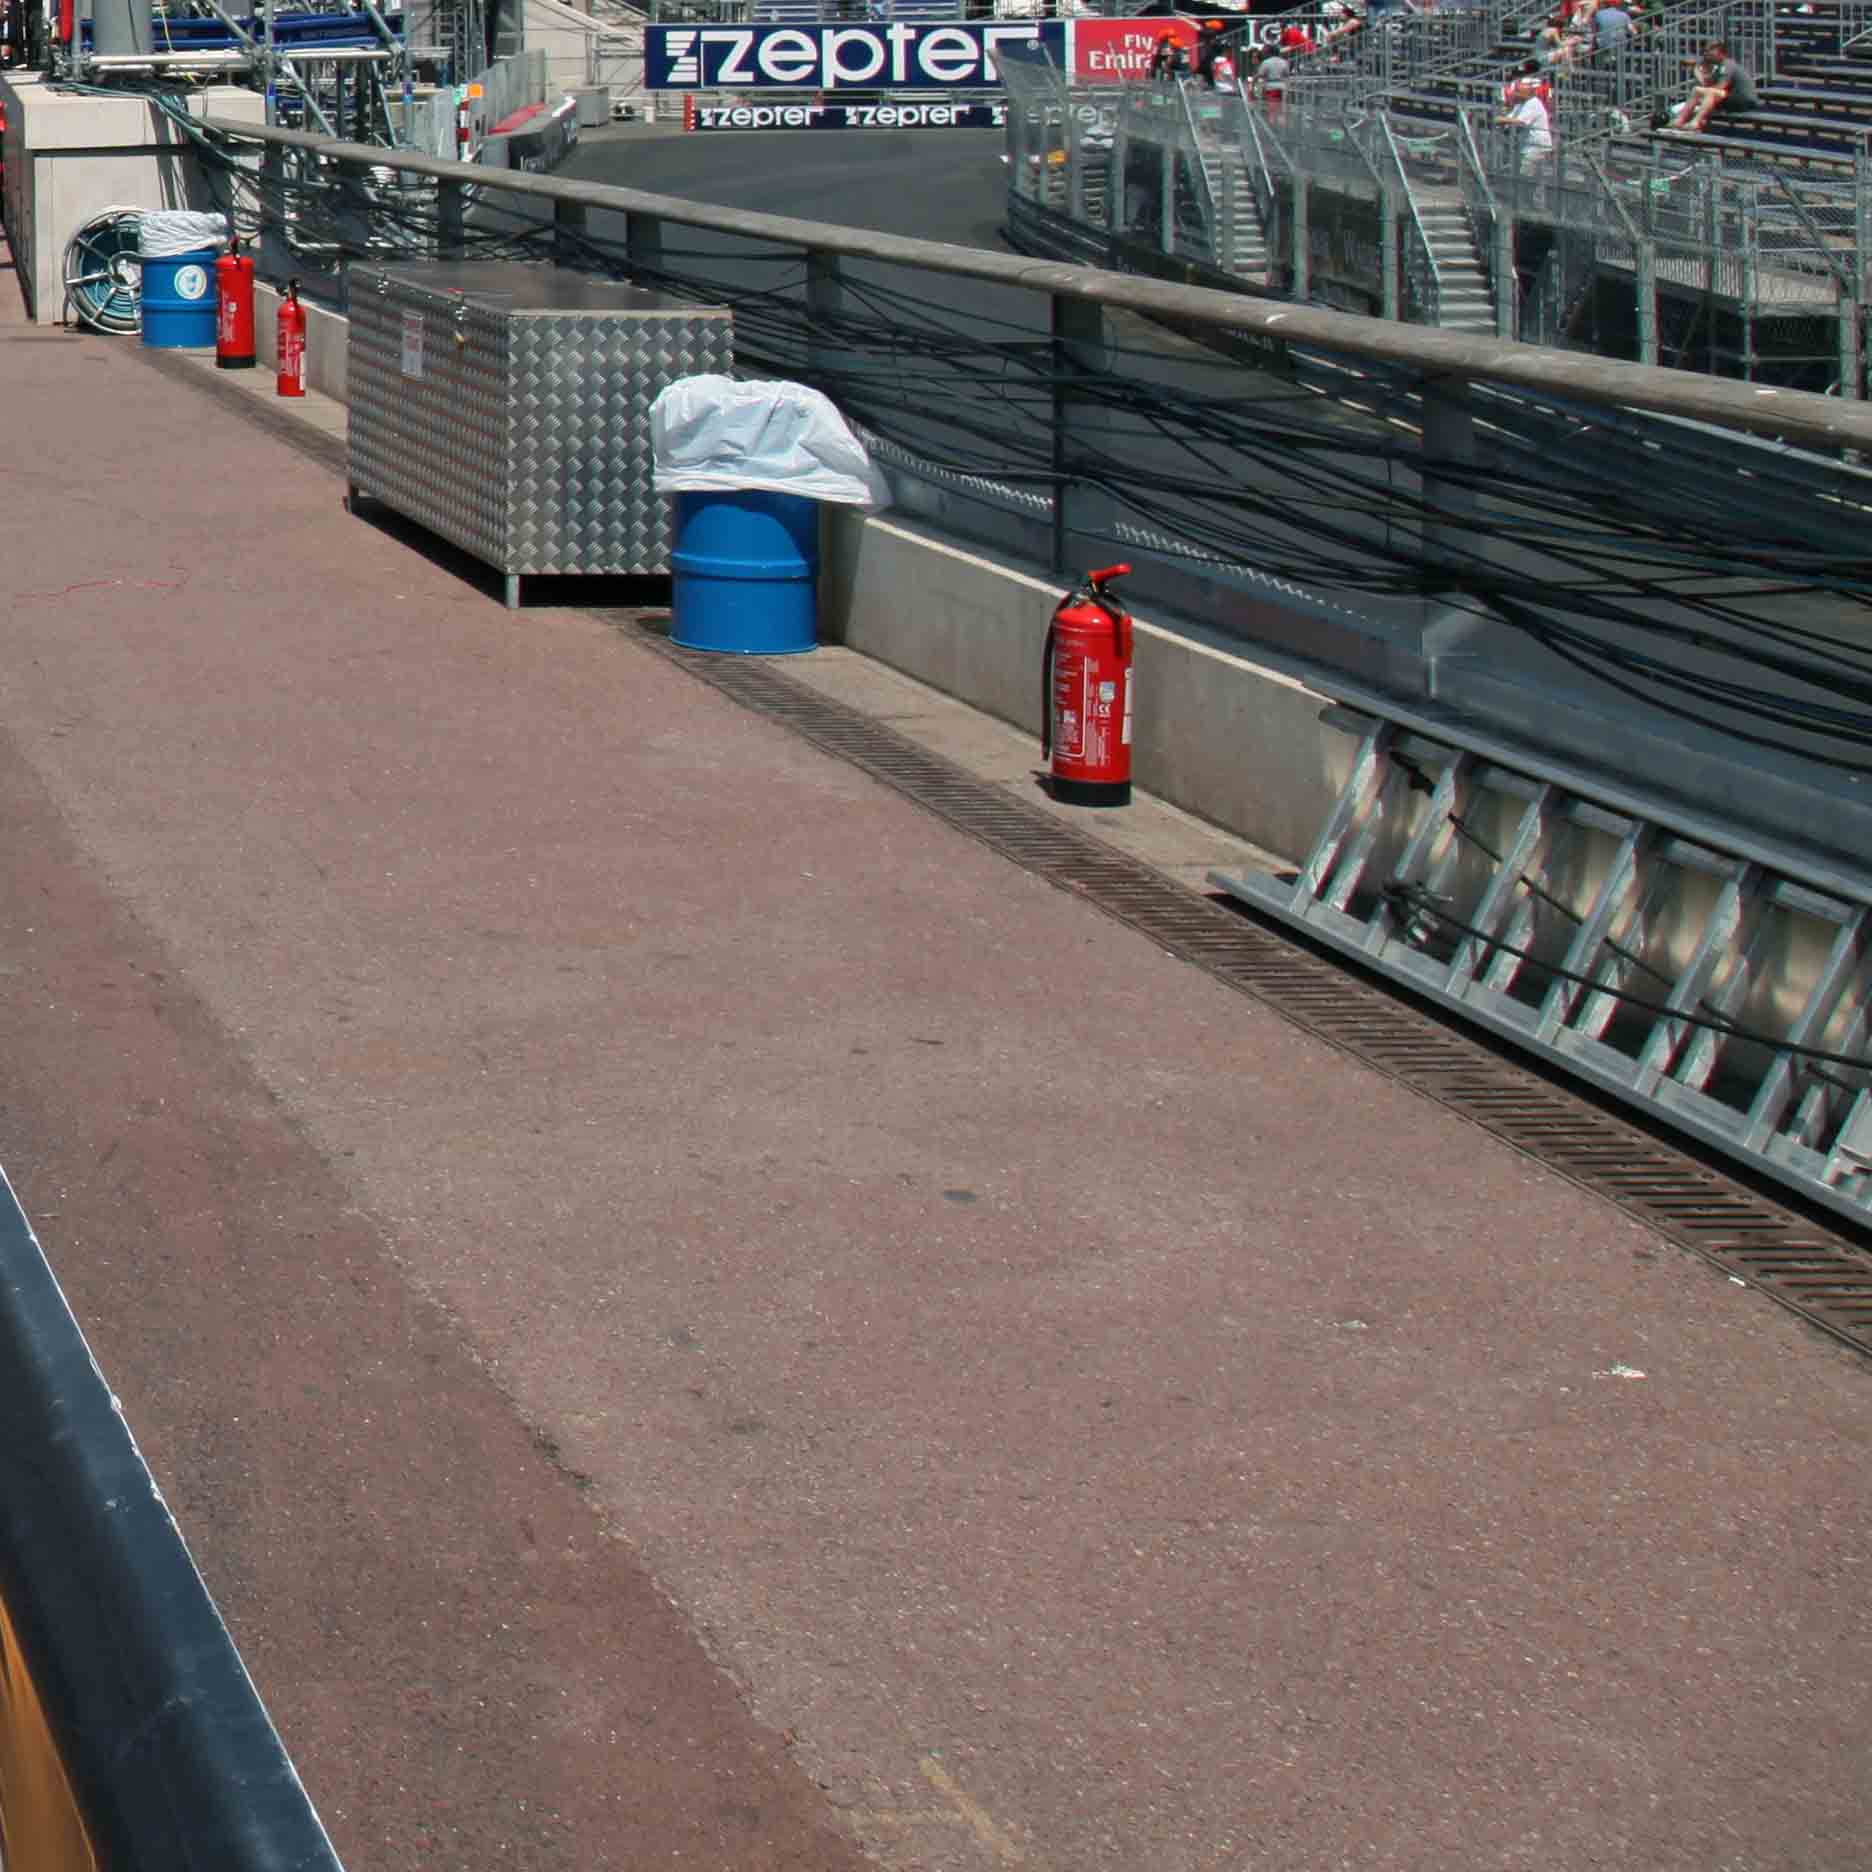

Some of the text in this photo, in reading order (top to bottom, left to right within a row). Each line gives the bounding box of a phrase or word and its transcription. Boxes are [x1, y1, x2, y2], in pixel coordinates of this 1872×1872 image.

[1124, 33, 1153, 50] Fly
[699, 22, 1040, 88] zepter
[713, 105, 824, 127] zepter
[859, 104, 971, 127] zepter
